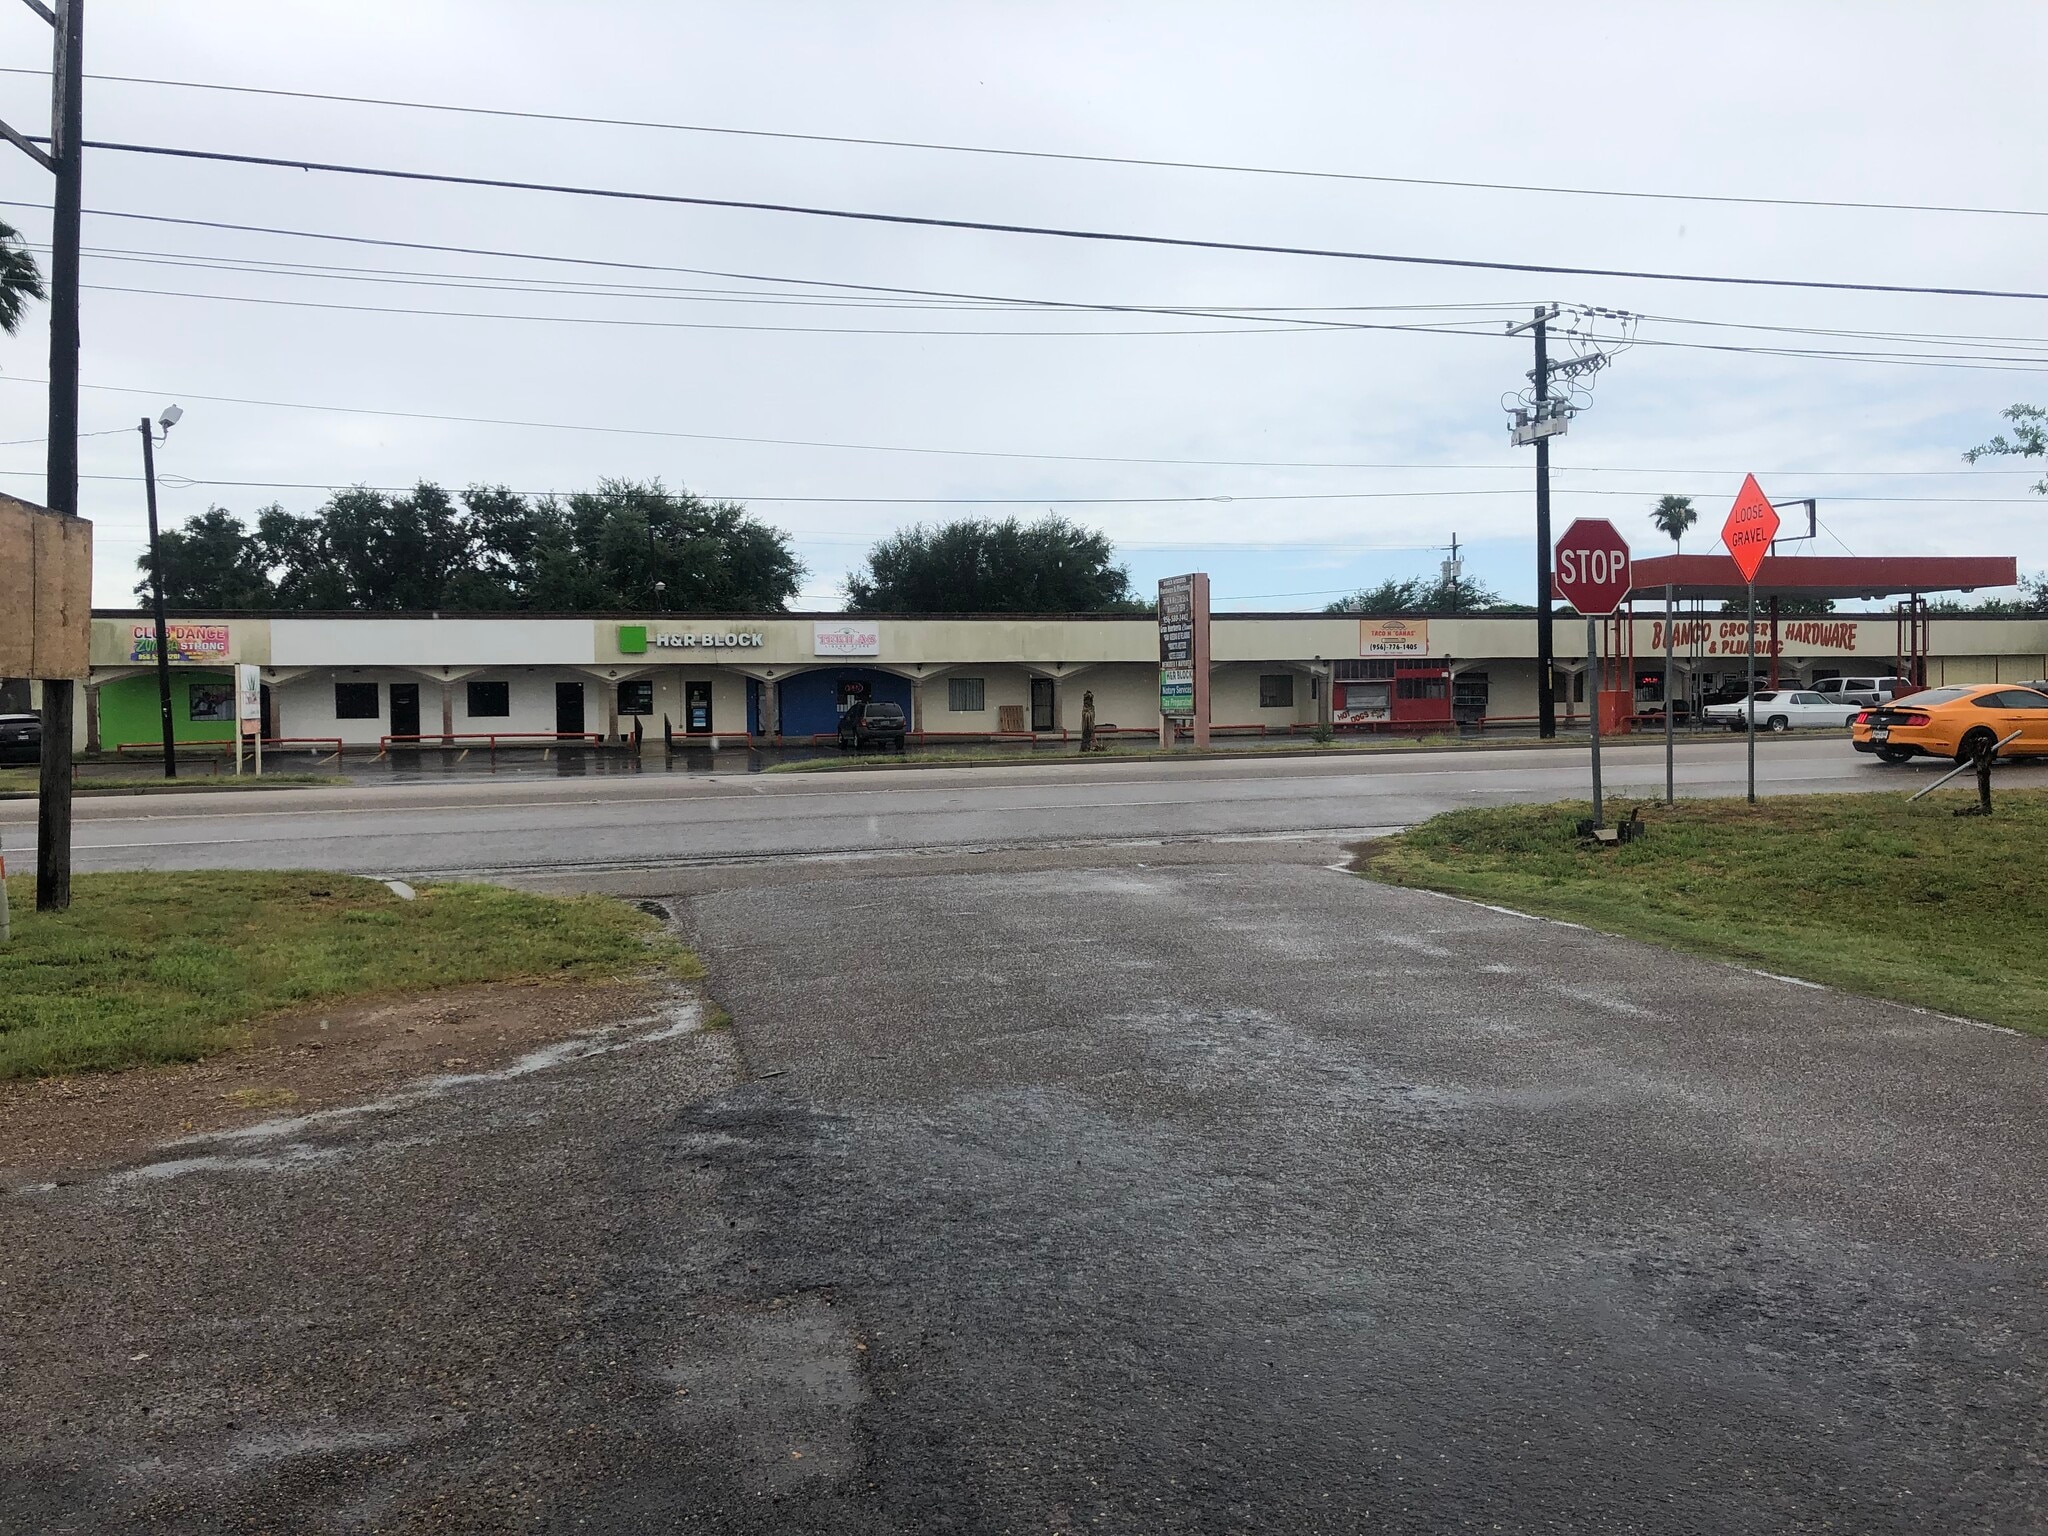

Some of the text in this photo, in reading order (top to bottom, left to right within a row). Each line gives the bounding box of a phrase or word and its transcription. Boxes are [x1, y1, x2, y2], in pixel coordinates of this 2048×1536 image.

[1735, 503, 1764, 524] LOOSE
[1732, 527, 1767, 547] GRAVEL
[1561, 549, 1625, 584] STOP
[176, 626, 225, 639] DANCE
[1719, 622, 1776, 639] GROER
[1785, 623, 1857, 651] HARDWARE
[134, 639, 225, 652] ZUA STRONG
[656, 633, 764, 647] H&R BLOCK
[1370, 643, 1418, 651] (956)-776-1405
[1709, 641, 1716, 654] &
[1162, 685, 1192, 696] Notary Services
[1337, 710, 1369, 722] HOT DOGS
